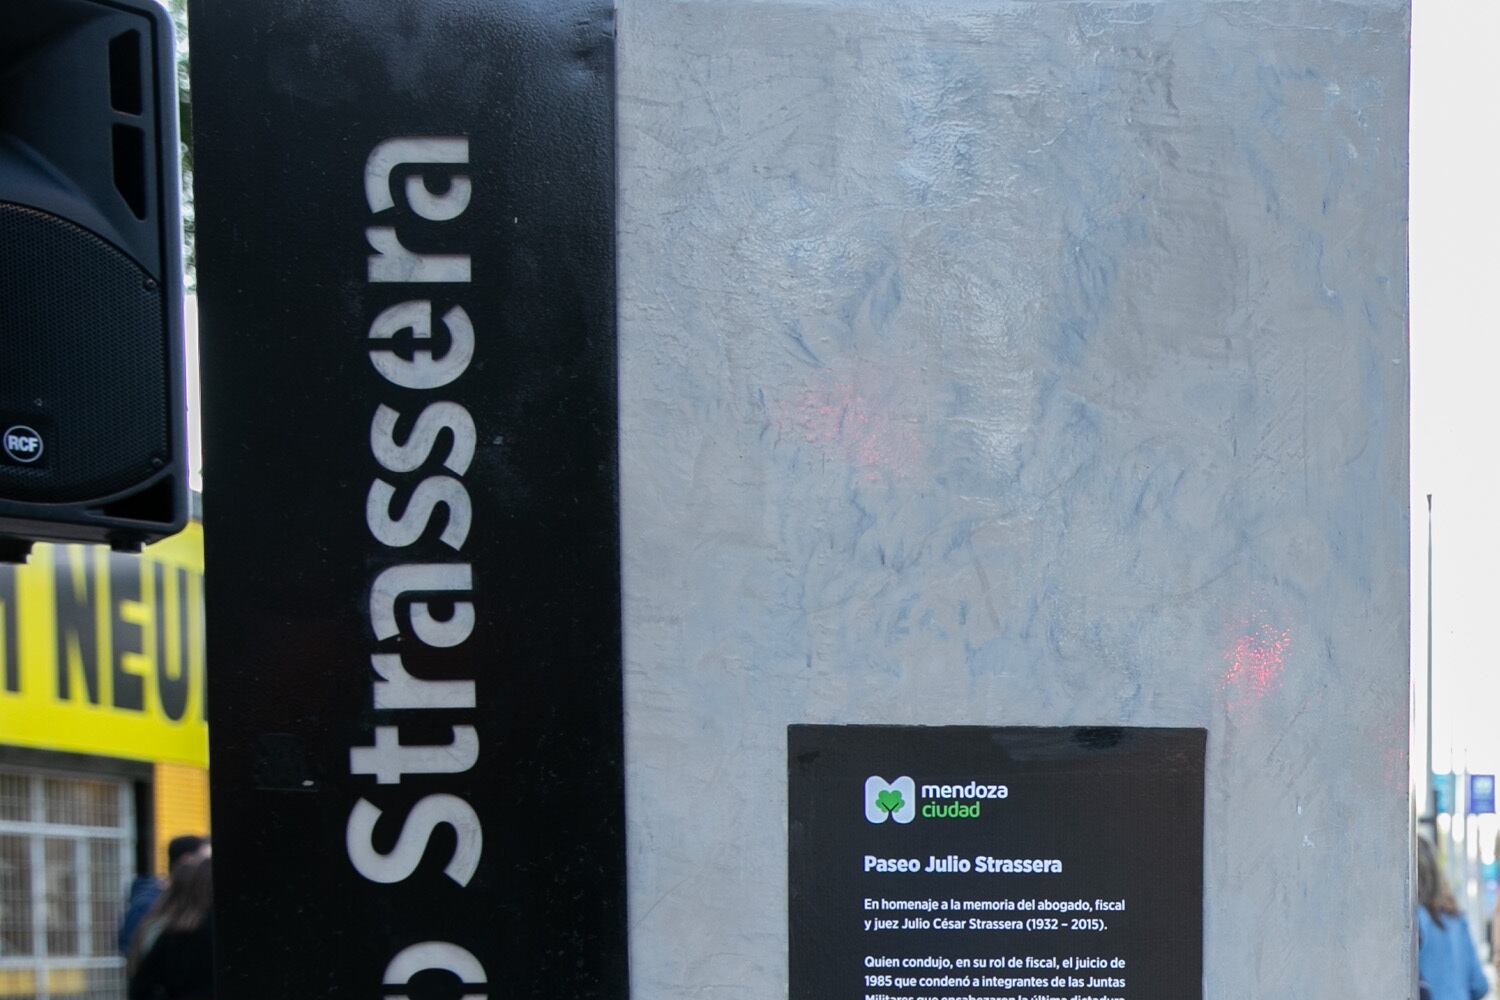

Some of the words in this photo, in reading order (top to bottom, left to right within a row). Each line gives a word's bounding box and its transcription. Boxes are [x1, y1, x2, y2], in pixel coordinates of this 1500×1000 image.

[8, 435, 38, 452] RCF
[346, 134, 484, 887] Strassera
[52, 541, 207, 721] NEU
[921, 780, 1009, 799] mendoza
[921, 800, 981, 818] ciudad
[864, 855, 921, 873] Paseo
[924, 855, 971, 873] Julio
[974, 856, 1062, 873] Strassera
[864, 898, 880, 910] En
[881, 898, 940, 912] homenaje
[940, 900, 949, 910] a
[950, 898, 961, 910] la
[962, 898, 1015, 911] memoria
[1016, 898, 1036, 911] del
[1037, 898, 1093, 913] abogado,
[1094, 899, 1126, 911] fiscal
[864, 920, 872, 931] y
[873, 917, 899, 931] juez
[901, 917, 931, 930] Julio
[932, 918, 967, 930] César
[968, 918, 1024, 930] Strassera
[1025, 918, 1059, 932] (1932
[1070, 918, 1108, 932] 2015).
[864, 956, 900, 968] Quien
[902, 956, 954, 970] condujo,
[955, 958, 971, 968] en
[972, 958, 987, 968] su
[989, 956, 1006, 968] rol
[1007, 956, 1024, 968] de
[1025, 956, 1060, 970] fiscal,
[1062, 956, 1073, 969] el
[1074, 956, 1108, 970] juicio
[1110, 956, 1126, 969] de
[864, 975, 893, 987] 1985
[894, 977, 918, 989] que
[918, 975, 971, 987] condenó
[972, 978, 980, 987] a
[982, 975, 1049, 990] integrantes
[1050, 976, 1066, 988] de
[1068, 976, 1085, 988] las
[1086, 976, 1126, 988] Juntas
